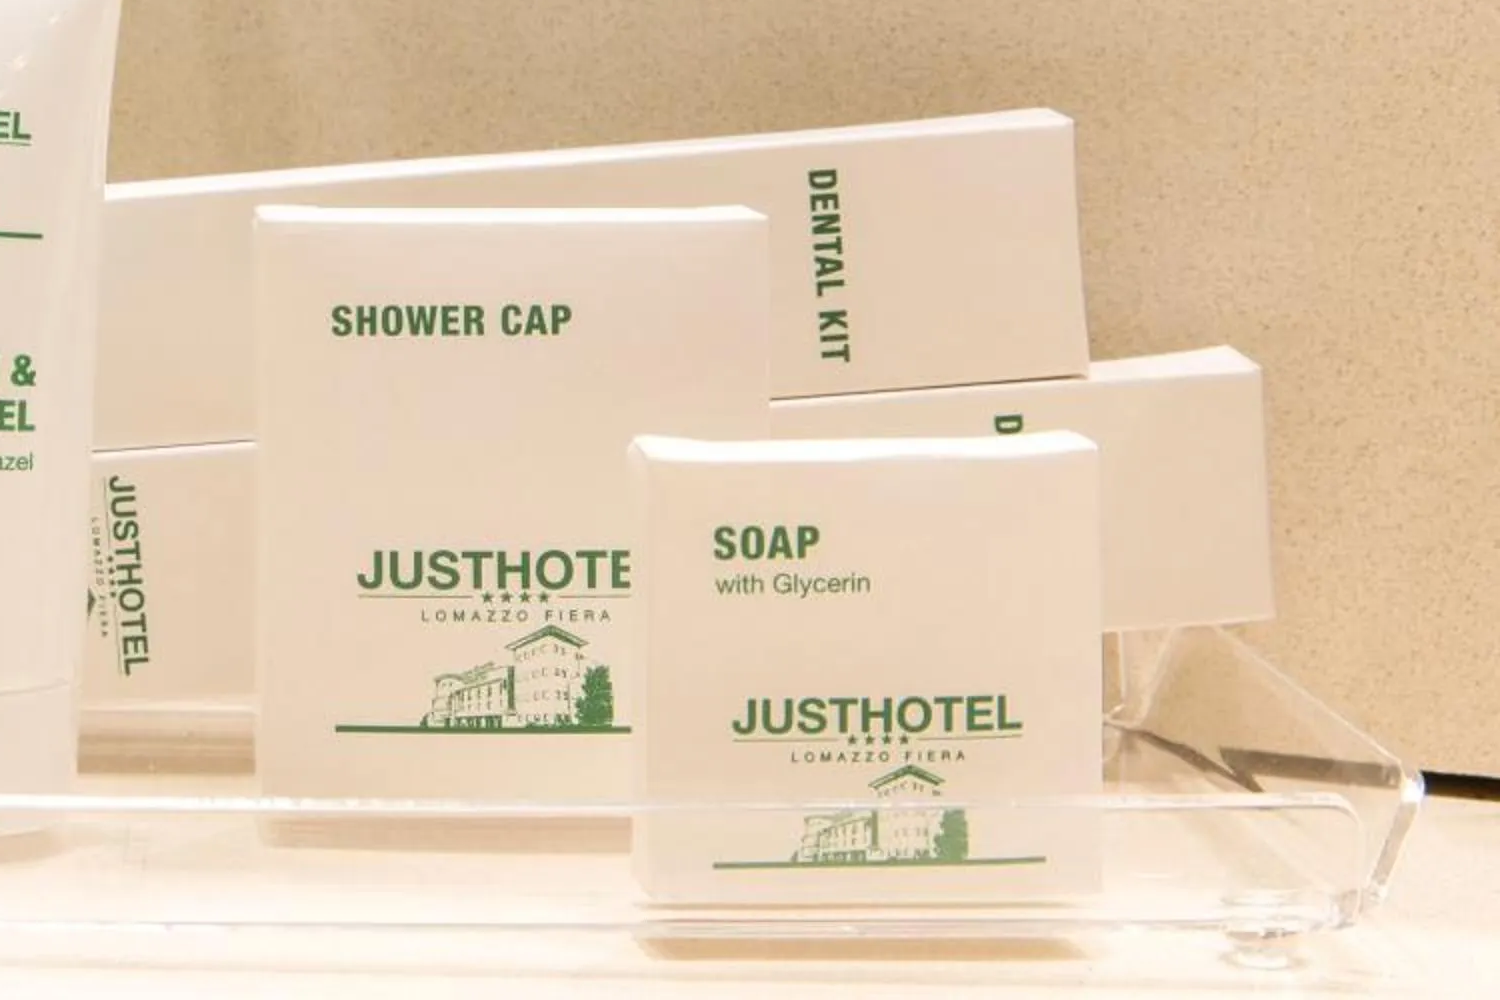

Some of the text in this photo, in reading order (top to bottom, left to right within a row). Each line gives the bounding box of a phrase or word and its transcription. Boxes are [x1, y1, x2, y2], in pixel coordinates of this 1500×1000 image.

[807, 168, 851, 363] DENTAL KIT
[331, 304, 572, 337] SHOWER CAP
[10, 353, 37, 387] &
[713, 525, 820, 561] SOAP
[108, 474, 150, 677] JUSTHOTEL
[356, 549, 631, 591] JUSTHOTE
[714, 572, 871, 599] with Glycerin
[420, 608, 611, 623] LOMAZZO FIERA
[731, 695, 1023, 736] JUSTHOTEL
[790, 750, 965, 764] LOMAZZO FIERA
